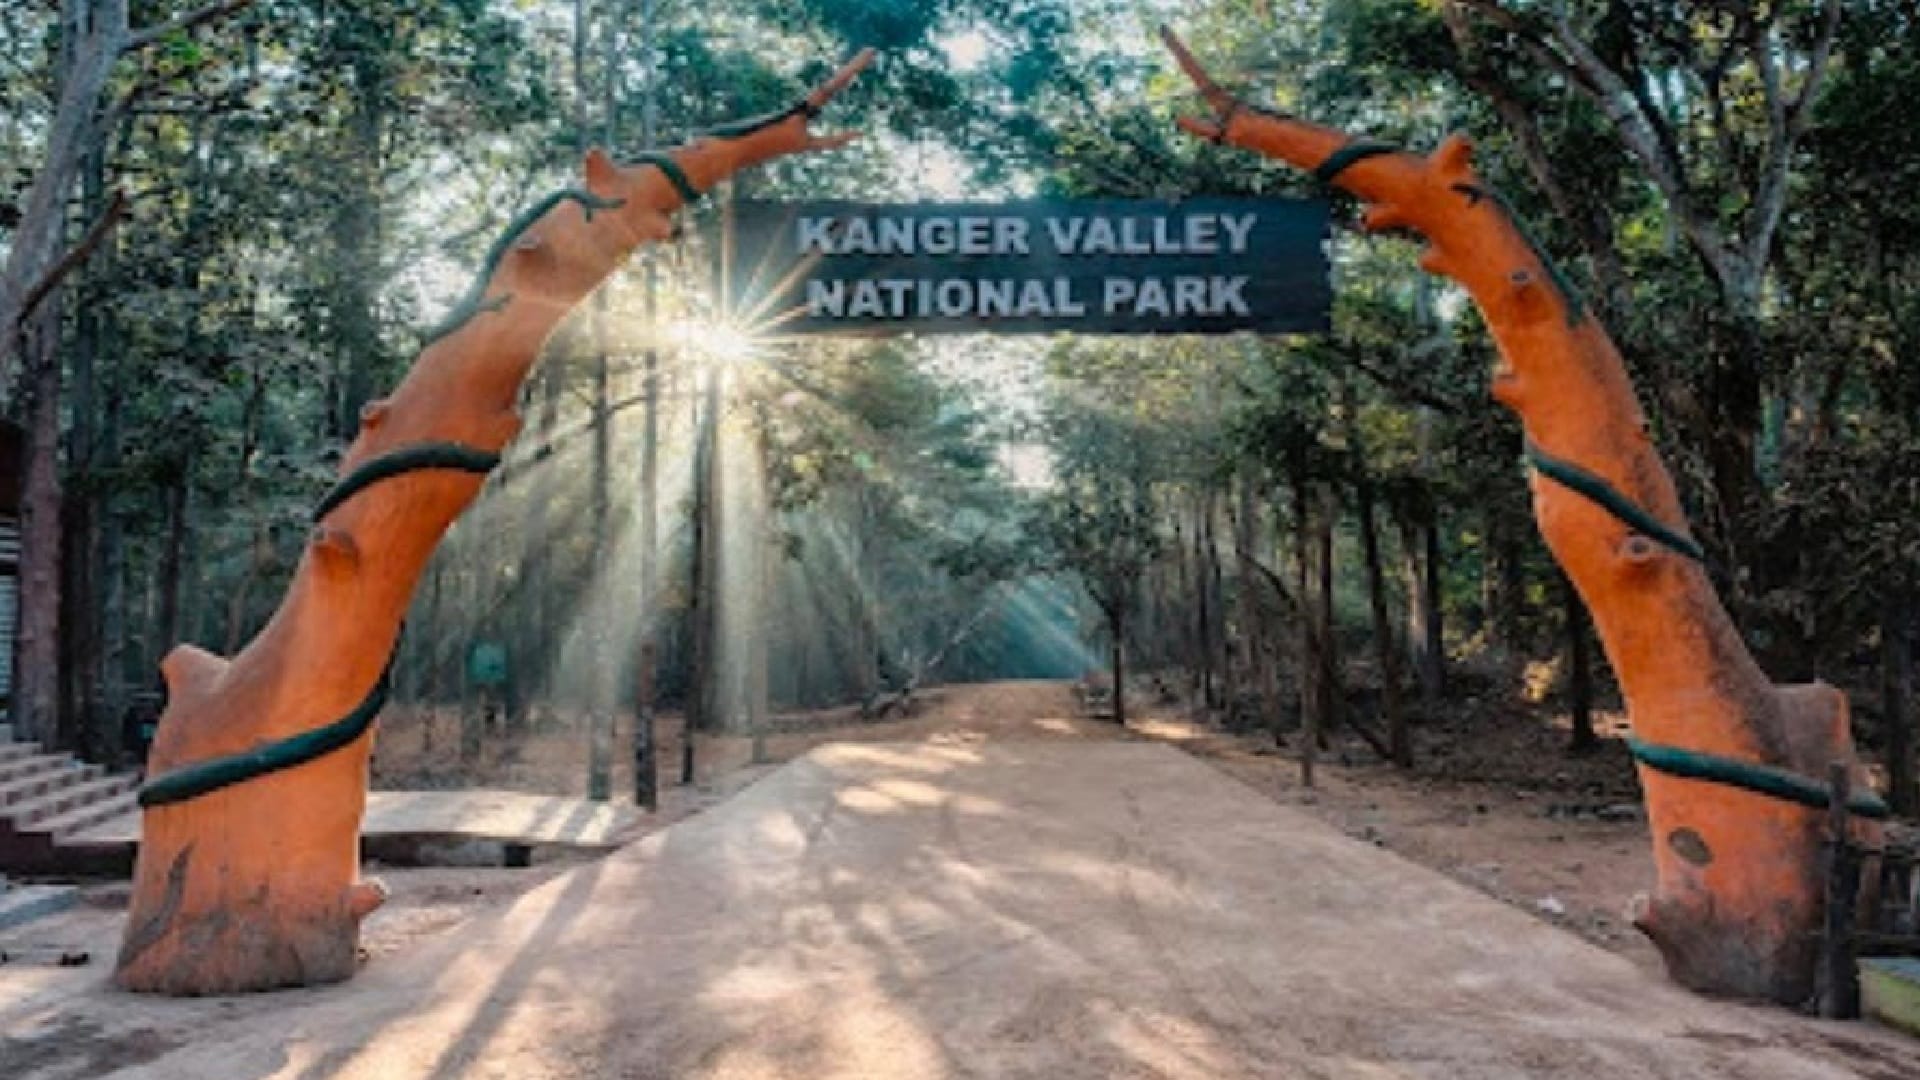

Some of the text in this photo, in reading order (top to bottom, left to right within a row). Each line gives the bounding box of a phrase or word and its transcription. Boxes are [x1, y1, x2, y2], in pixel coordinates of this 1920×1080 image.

[799, 213, 1257, 254] KANGER VALLEY
[808, 276, 1250, 317] NATIONAL PARK
